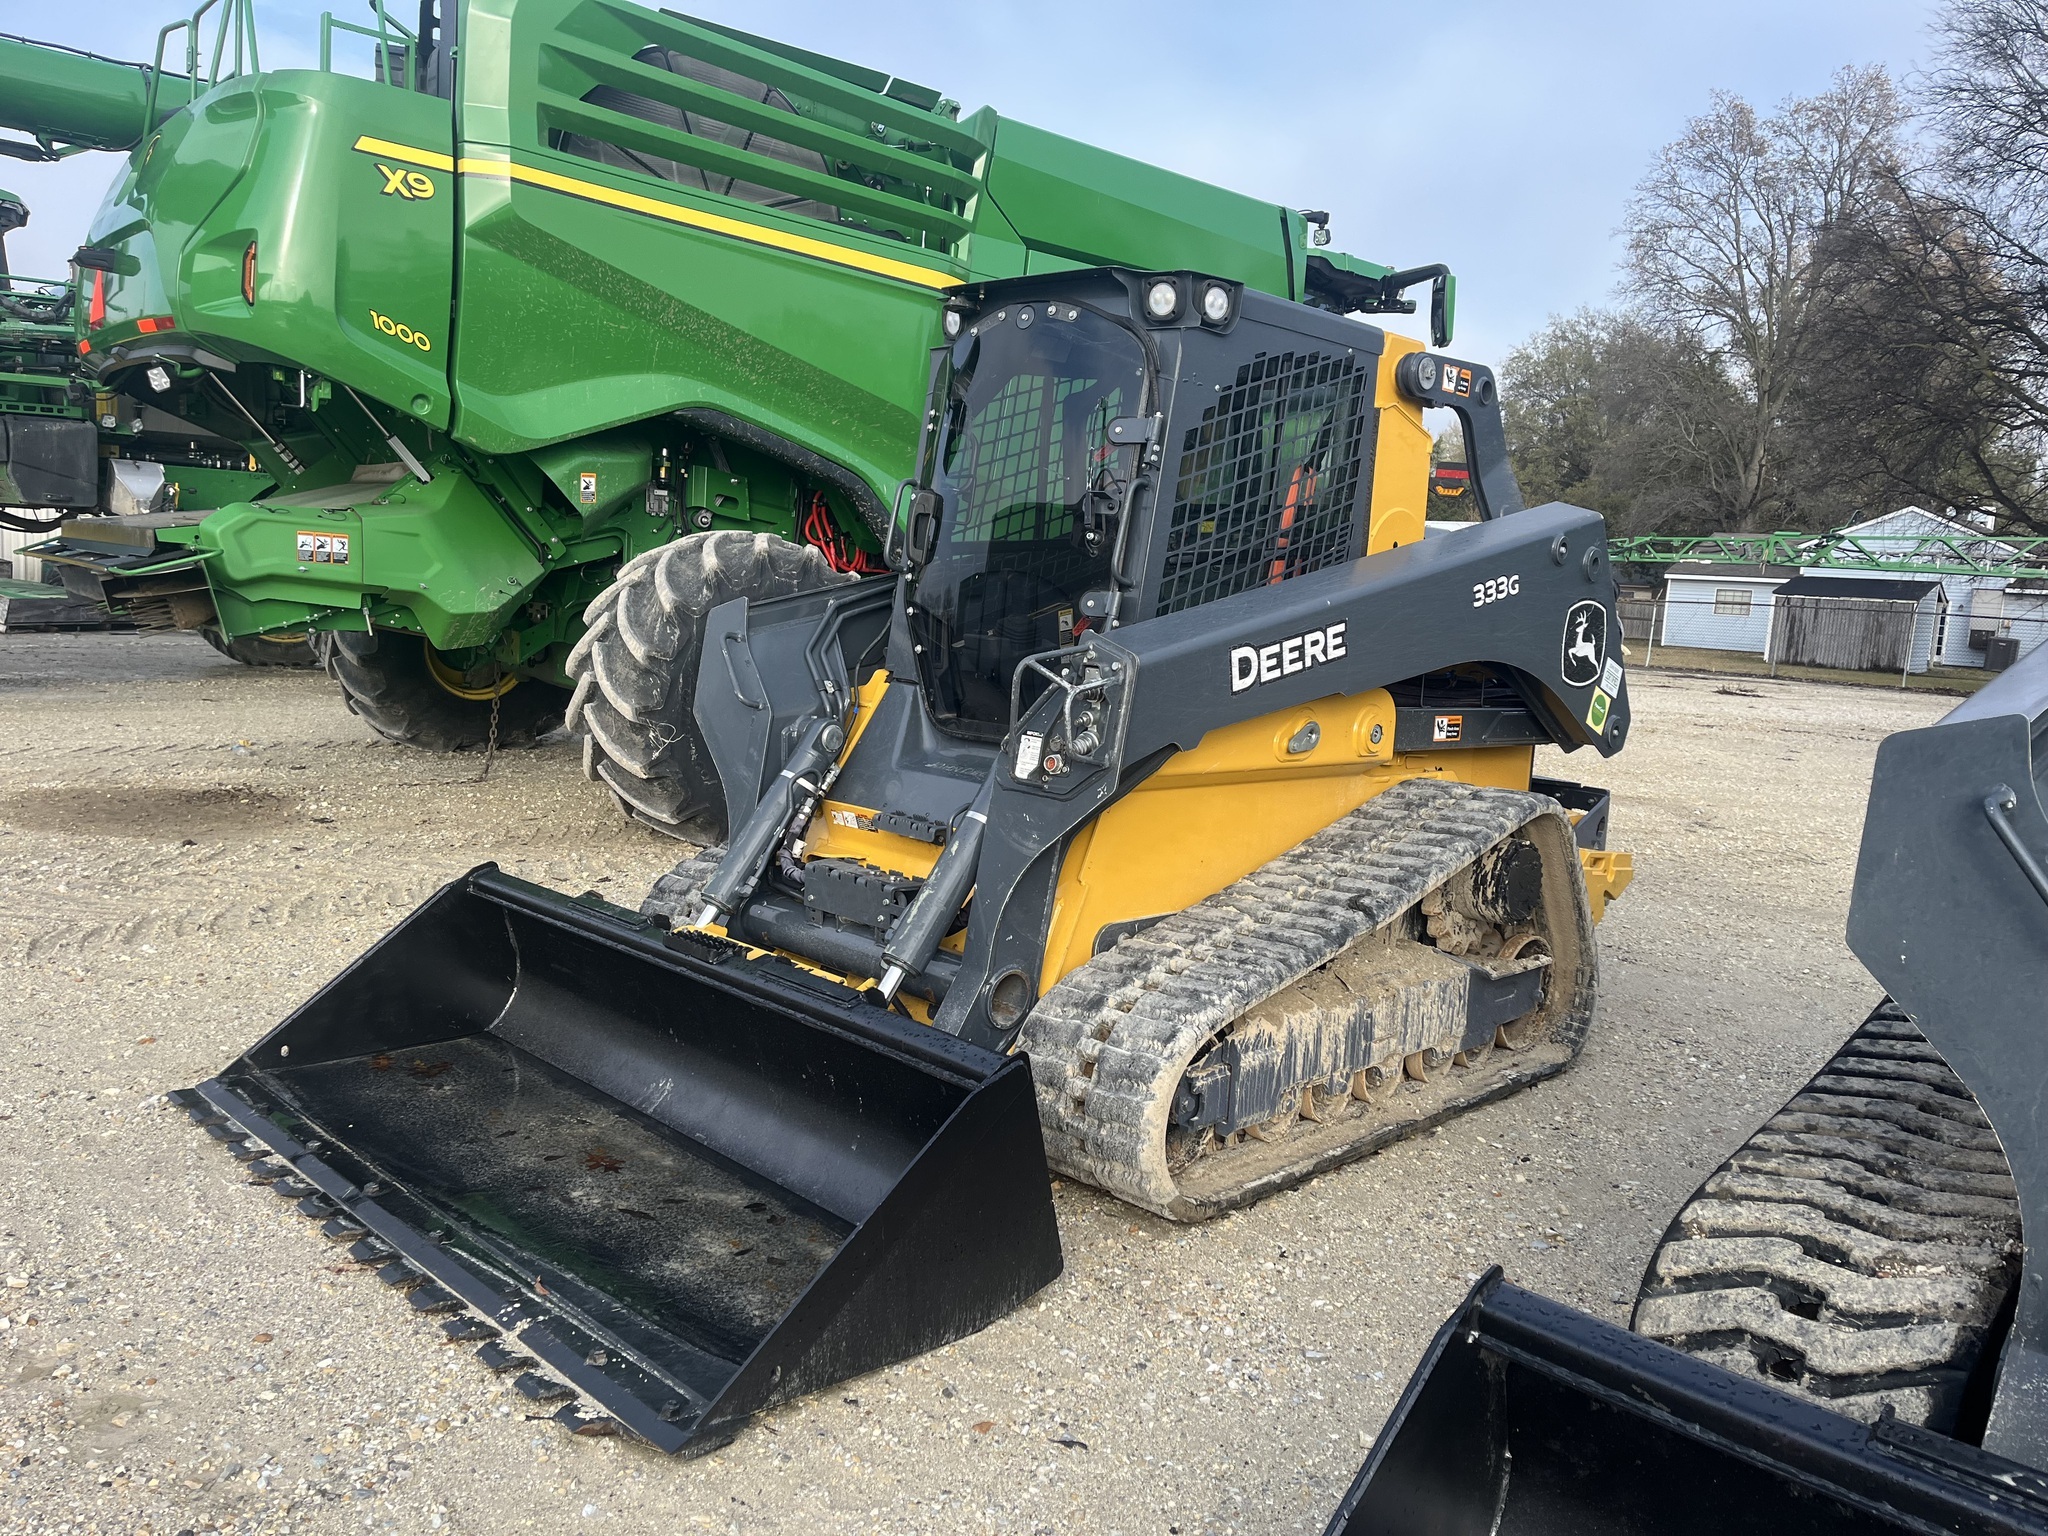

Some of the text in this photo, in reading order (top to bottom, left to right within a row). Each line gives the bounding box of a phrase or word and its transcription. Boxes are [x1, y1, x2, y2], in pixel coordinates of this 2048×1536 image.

[375, 163, 435, 200] X9
[369, 309, 432, 352] 1000
[1473, 574, 1520, 608] 333G
[1230, 622, 1347, 692] DEERE
